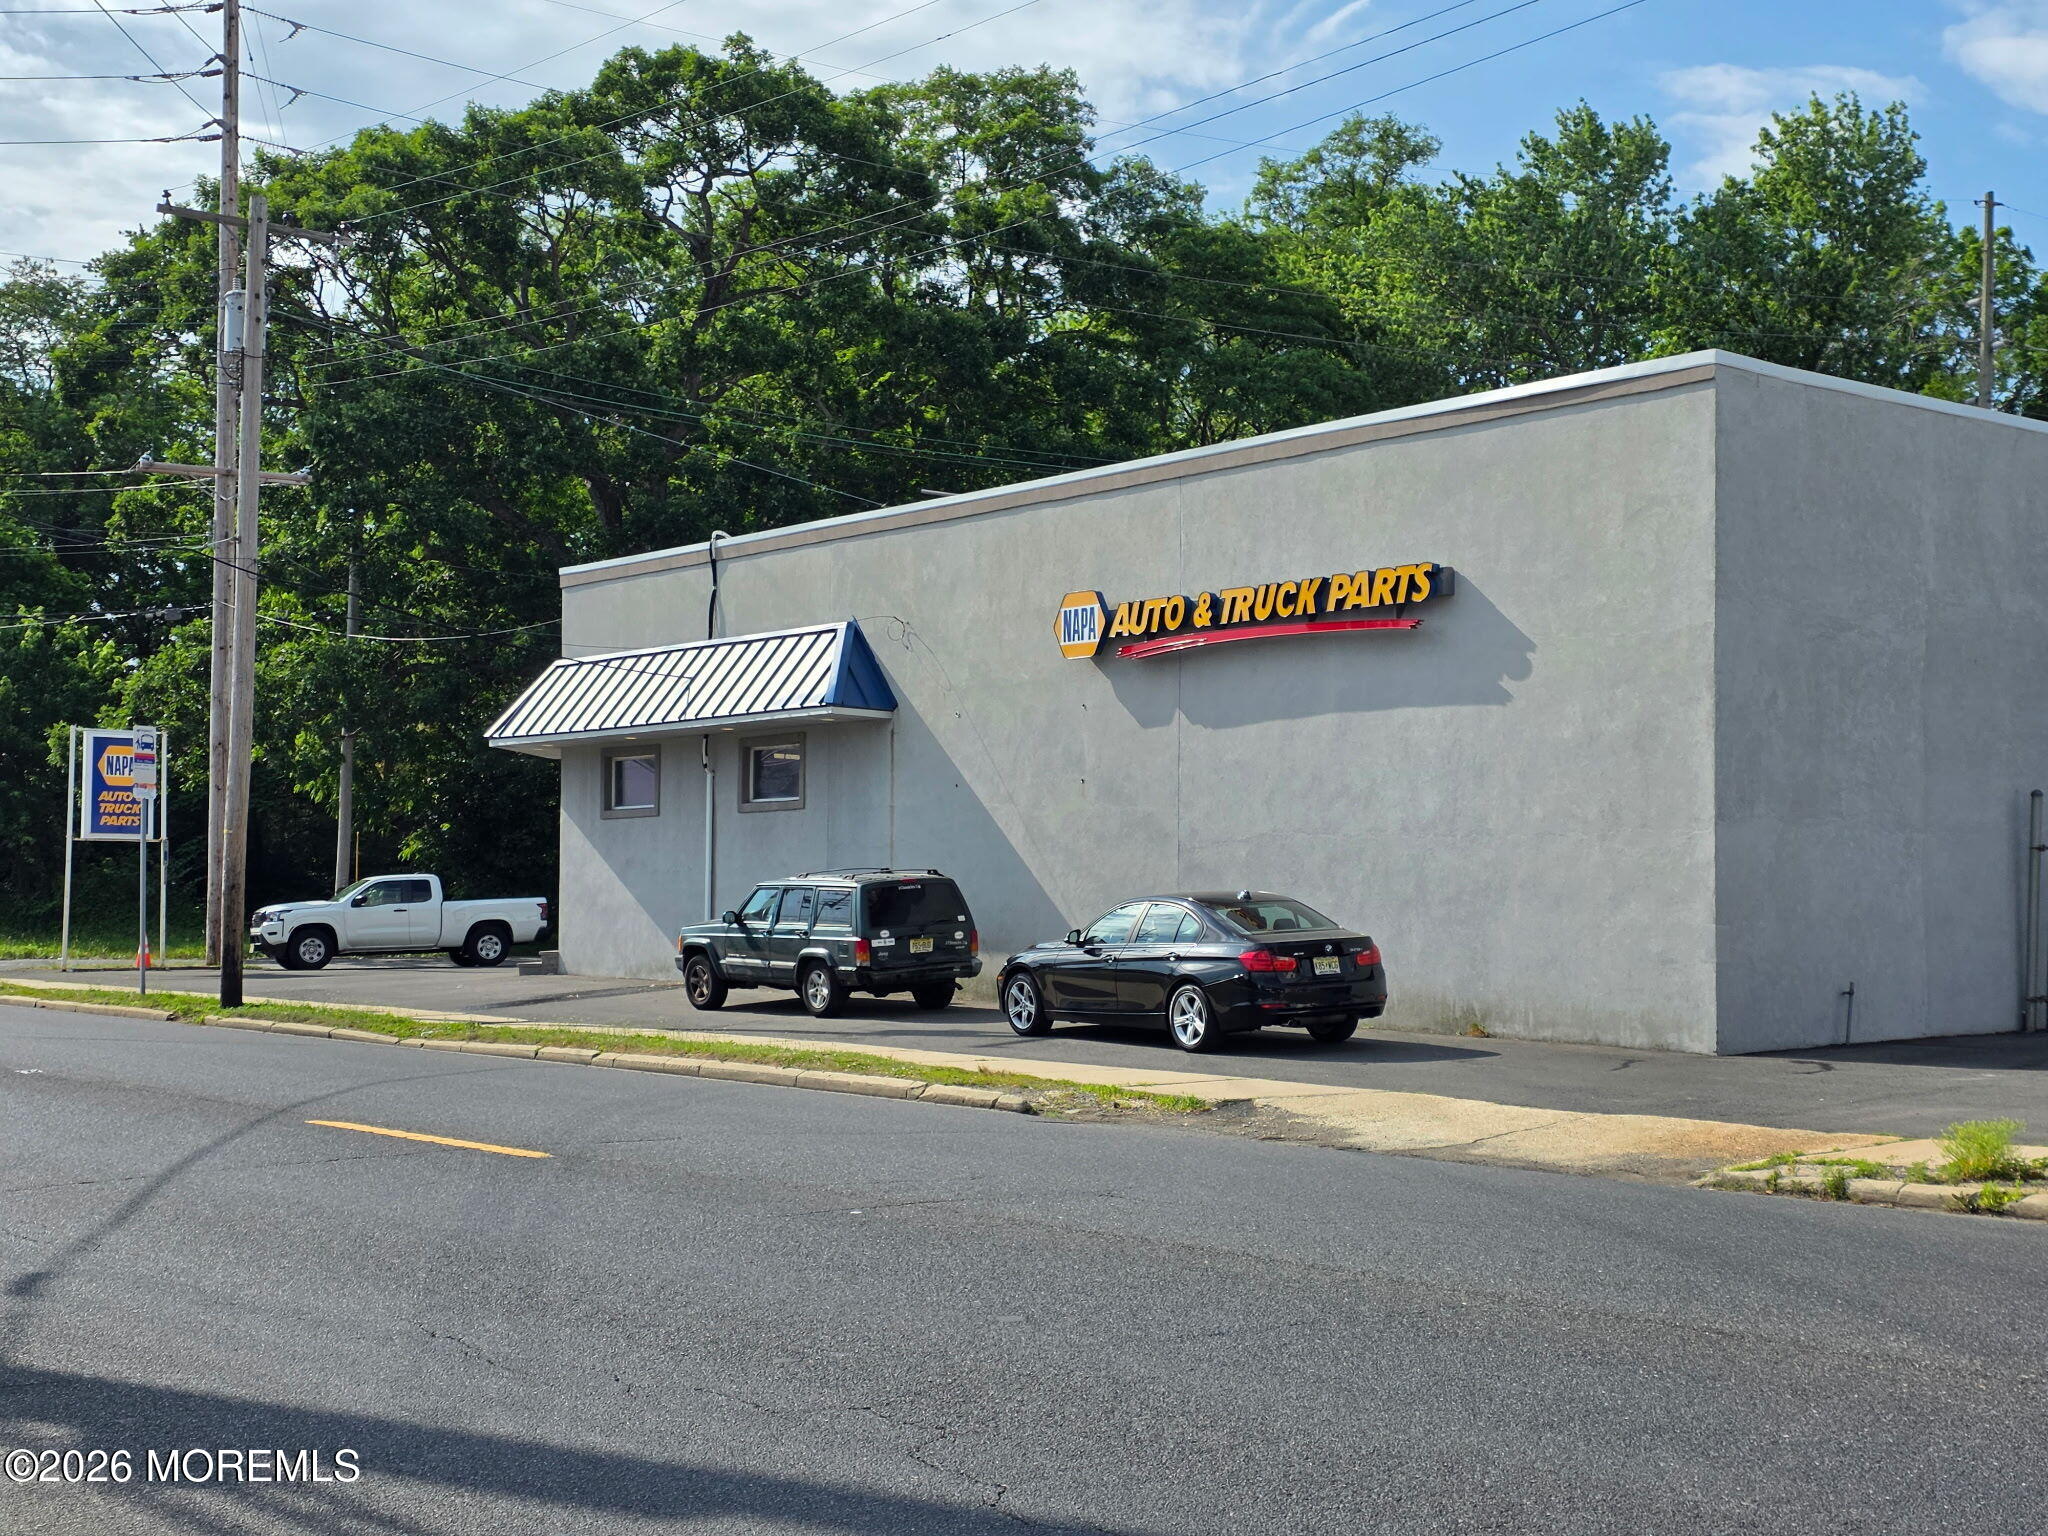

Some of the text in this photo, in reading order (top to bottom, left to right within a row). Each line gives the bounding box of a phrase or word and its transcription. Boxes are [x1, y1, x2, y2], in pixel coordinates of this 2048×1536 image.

[1108, 562, 1433, 638] AUTO & TRUCK PARTS
[1063, 606, 1097, 643] NAPA
[98, 791, 133, 801] AUTO
[100, 803, 141, 814] TRUCK
[100, 816, 141, 826] PARTS
